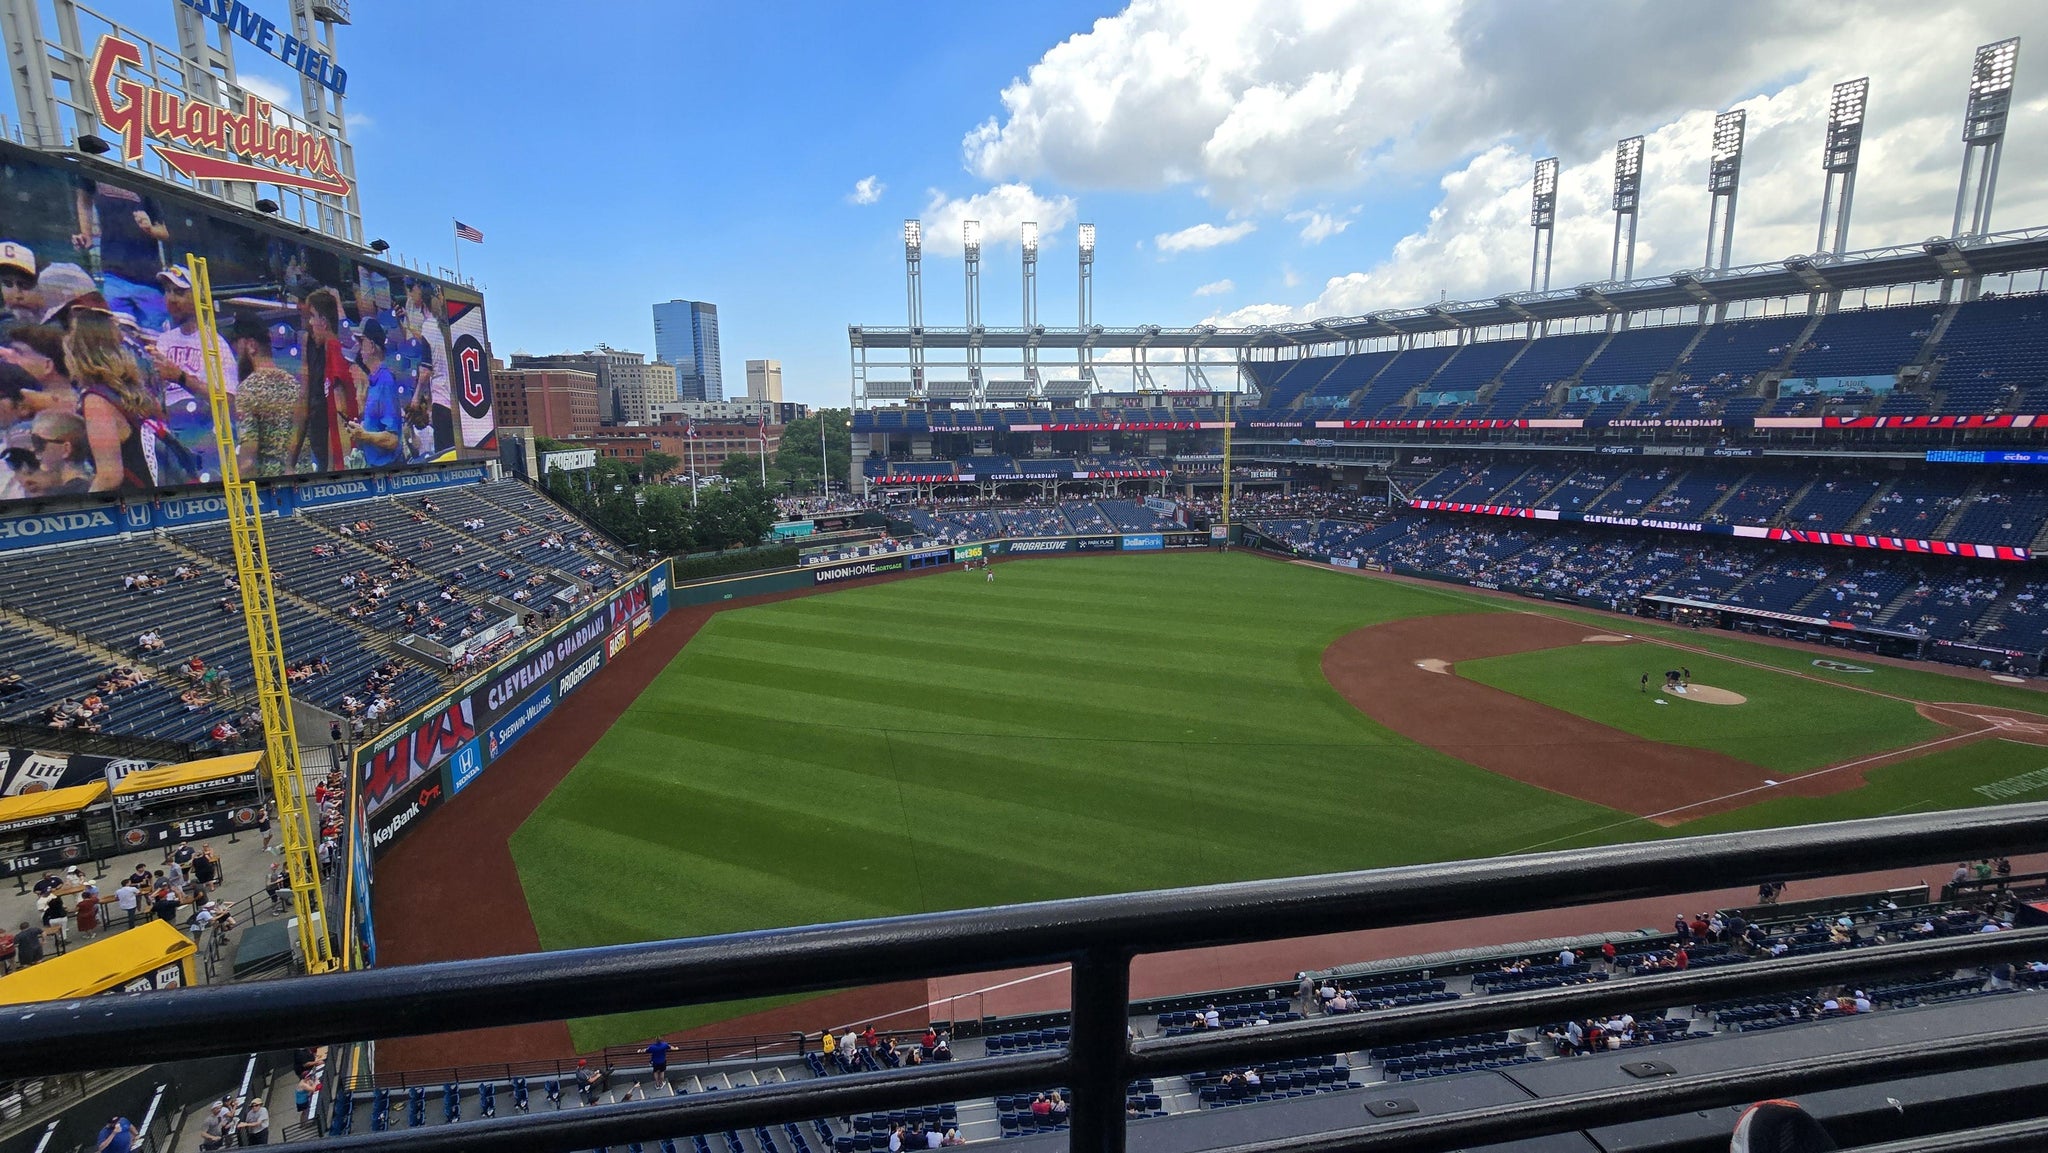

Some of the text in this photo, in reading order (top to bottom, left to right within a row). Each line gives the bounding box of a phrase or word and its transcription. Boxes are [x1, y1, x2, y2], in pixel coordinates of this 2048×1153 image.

[282, 34, 347, 95] FIELD
[90, 34, 342, 178] Guardians
[460, 347, 484, 407] C
[1664, 419, 1723, 427] GUARDIANS
[2003, 453, 2031, 461] echo
[401, 473, 440, 486] HONDA
[451, 468, 483, 480] HONDA
[314, 481, 368, 498] HONDA
[0, 511, 113, 539] HONDA
[1583, 514, 1702, 531] CLEVELAND GUARDIANS
[954, 547, 983, 560] bet365
[1010, 541, 1068, 552] PROGRESSIVE
[488, 650, 555, 711] CLEVELAND
[557, 615, 605, 662] GUARDIANS
[559, 651, 602, 698] PROGRESSIVE
[373, 723, 410, 754] PROGRESSIVE
[26, 762, 65, 779] Lite
[138, 787, 178, 799] PORCH
[179, 777, 235, 792] PRETZELS
[13, 816, 56, 828] NACHOS
[179, 819, 214, 838] Lite
[372, 802, 421, 848] KeyBank
[8, 856, 40, 871] Lite
